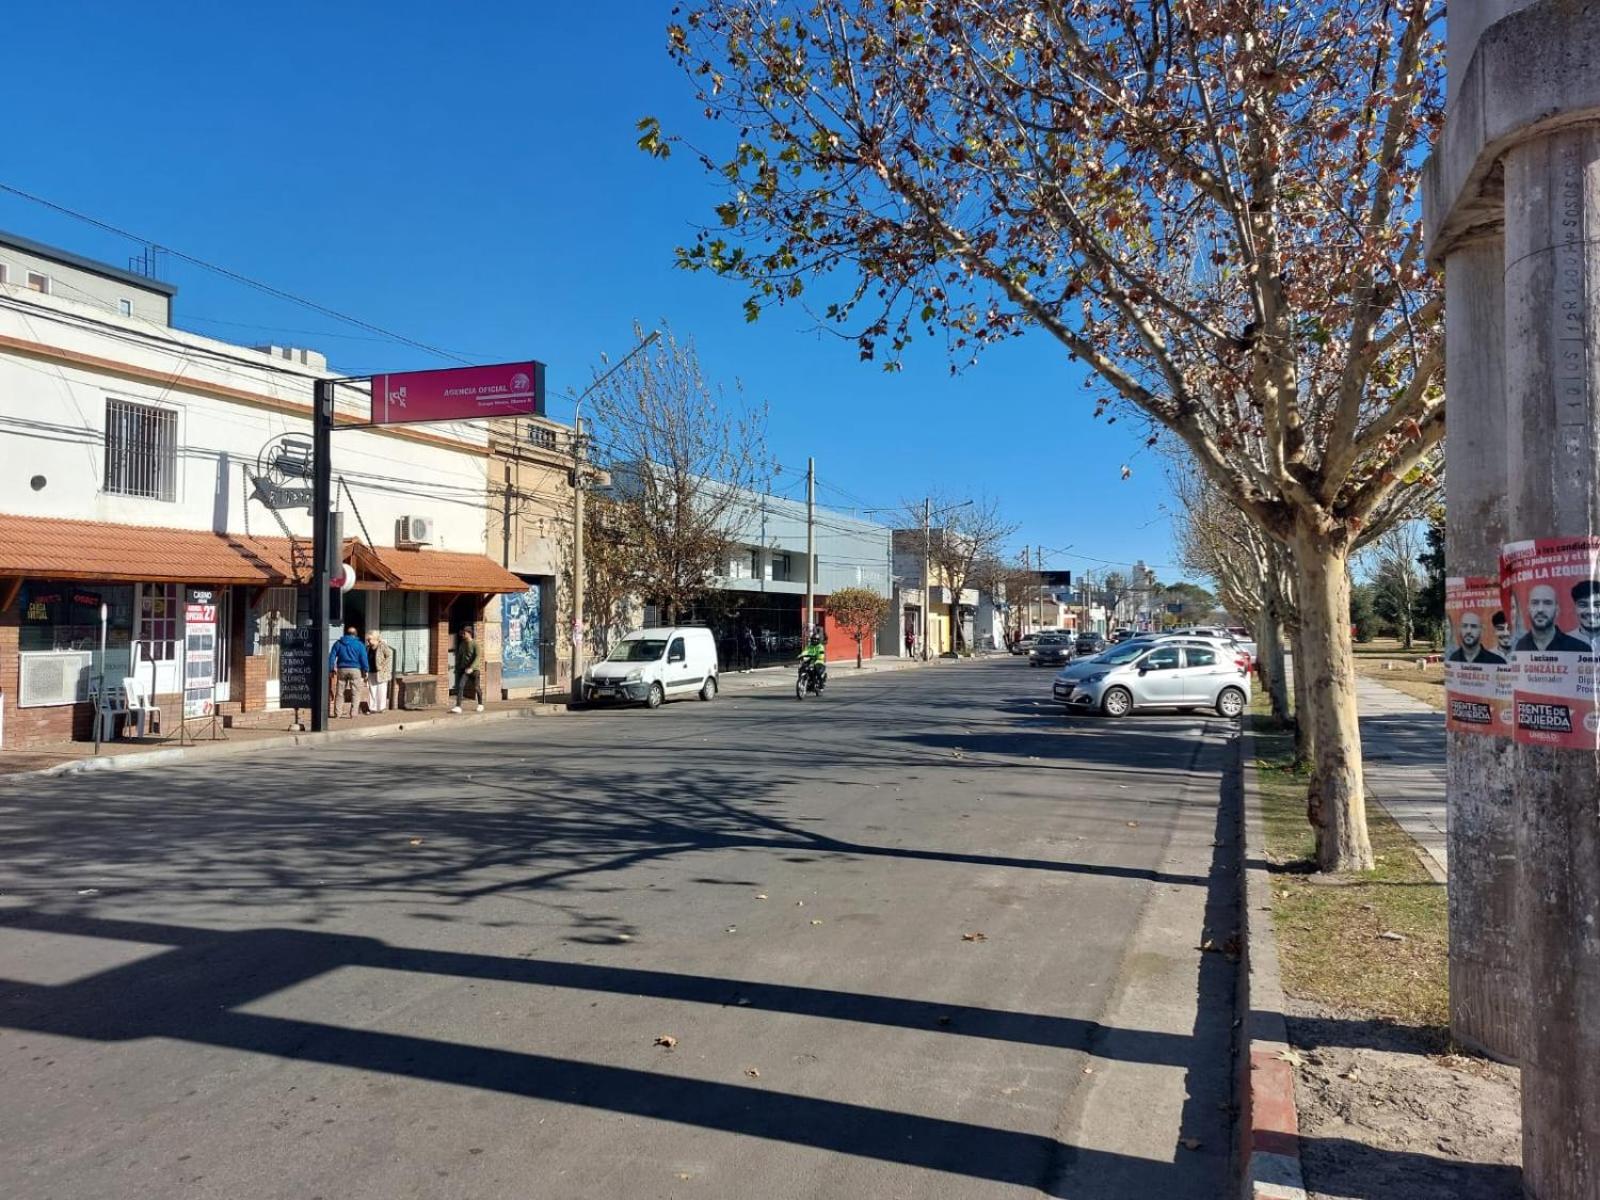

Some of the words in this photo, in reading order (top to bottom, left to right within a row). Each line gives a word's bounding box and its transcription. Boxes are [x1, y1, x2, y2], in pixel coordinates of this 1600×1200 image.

[444, 387, 477, 397] AGENCIA
[478, 384, 508, 394] OFICIAL
[1535, 567, 1549, 579] LA
[203, 605, 216, 621] 27
[1519, 703, 1553, 715] FRENTE
[1554, 707, 1566, 717] DE
[1518, 713, 1570, 727] IZQUIERDA
